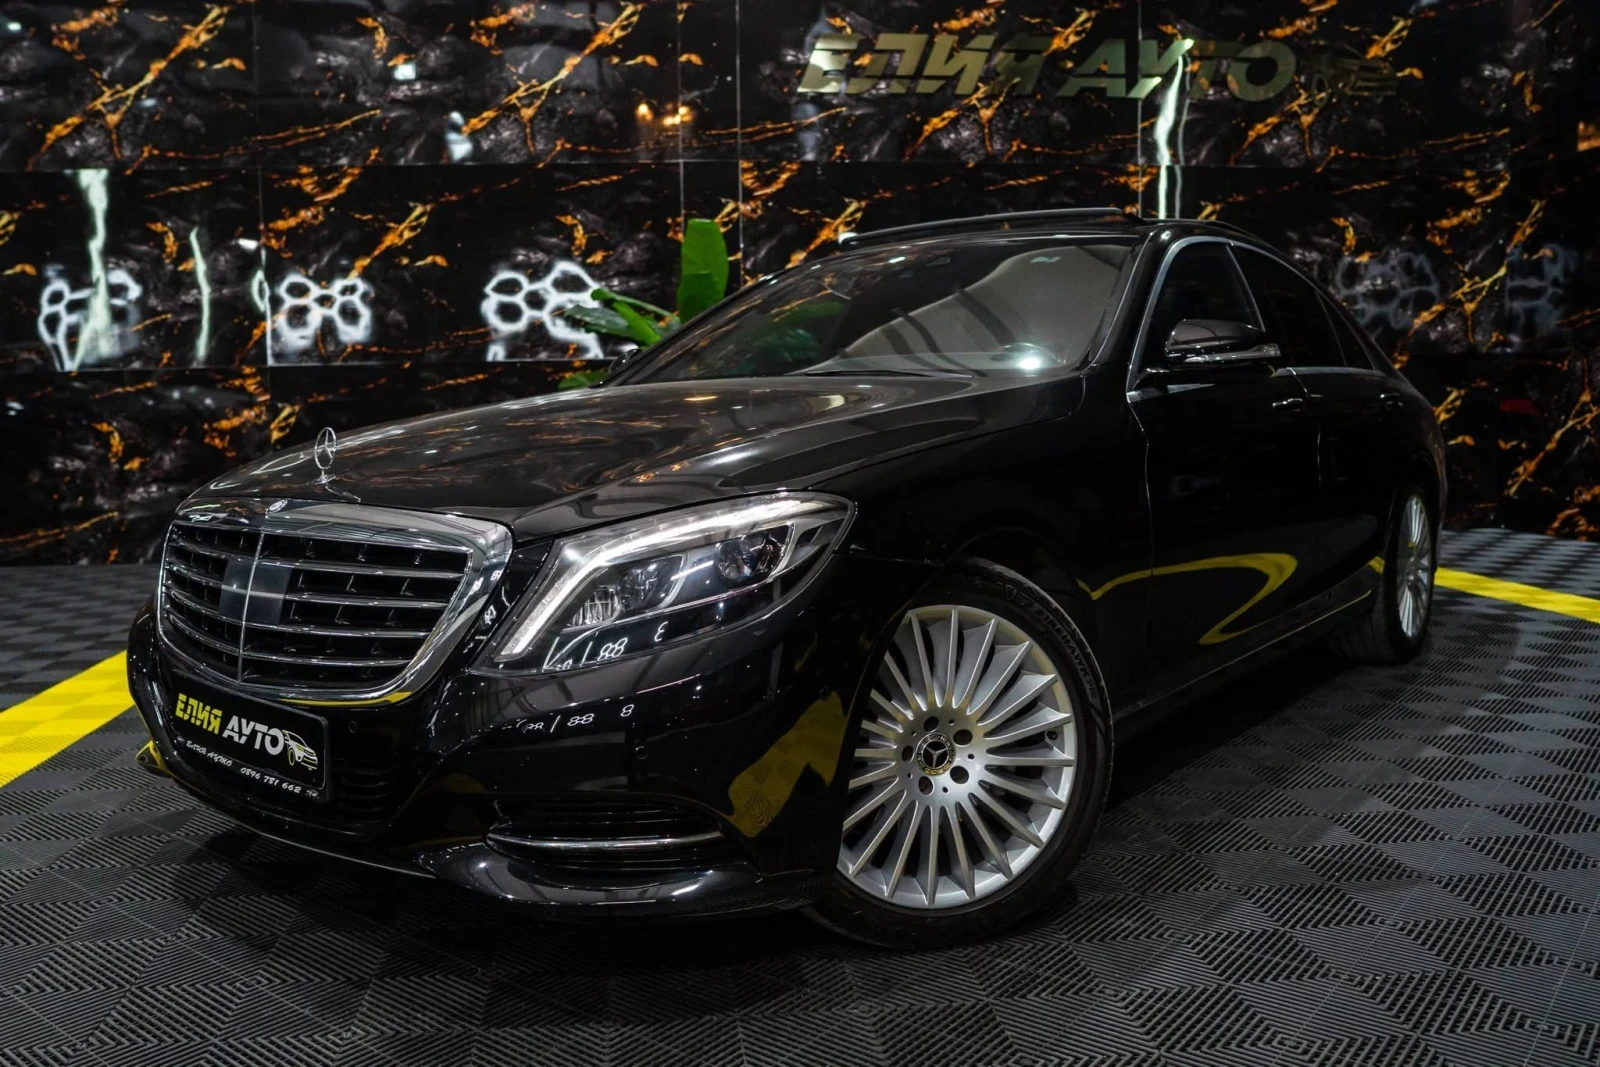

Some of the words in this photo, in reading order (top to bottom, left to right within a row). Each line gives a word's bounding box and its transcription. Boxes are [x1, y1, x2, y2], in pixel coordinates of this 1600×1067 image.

[798, 33, 1052, 97] ЕЛИЯ
[1056, 37, 1297, 101] АУТО
[175, 693, 223, 735] ЕЛИЯ
[222, 715, 285, 756] АУТО
[240, 767, 261, 780] 0896
[263, 775, 279, 787] 781
[281, 782, 302, 794] 662
